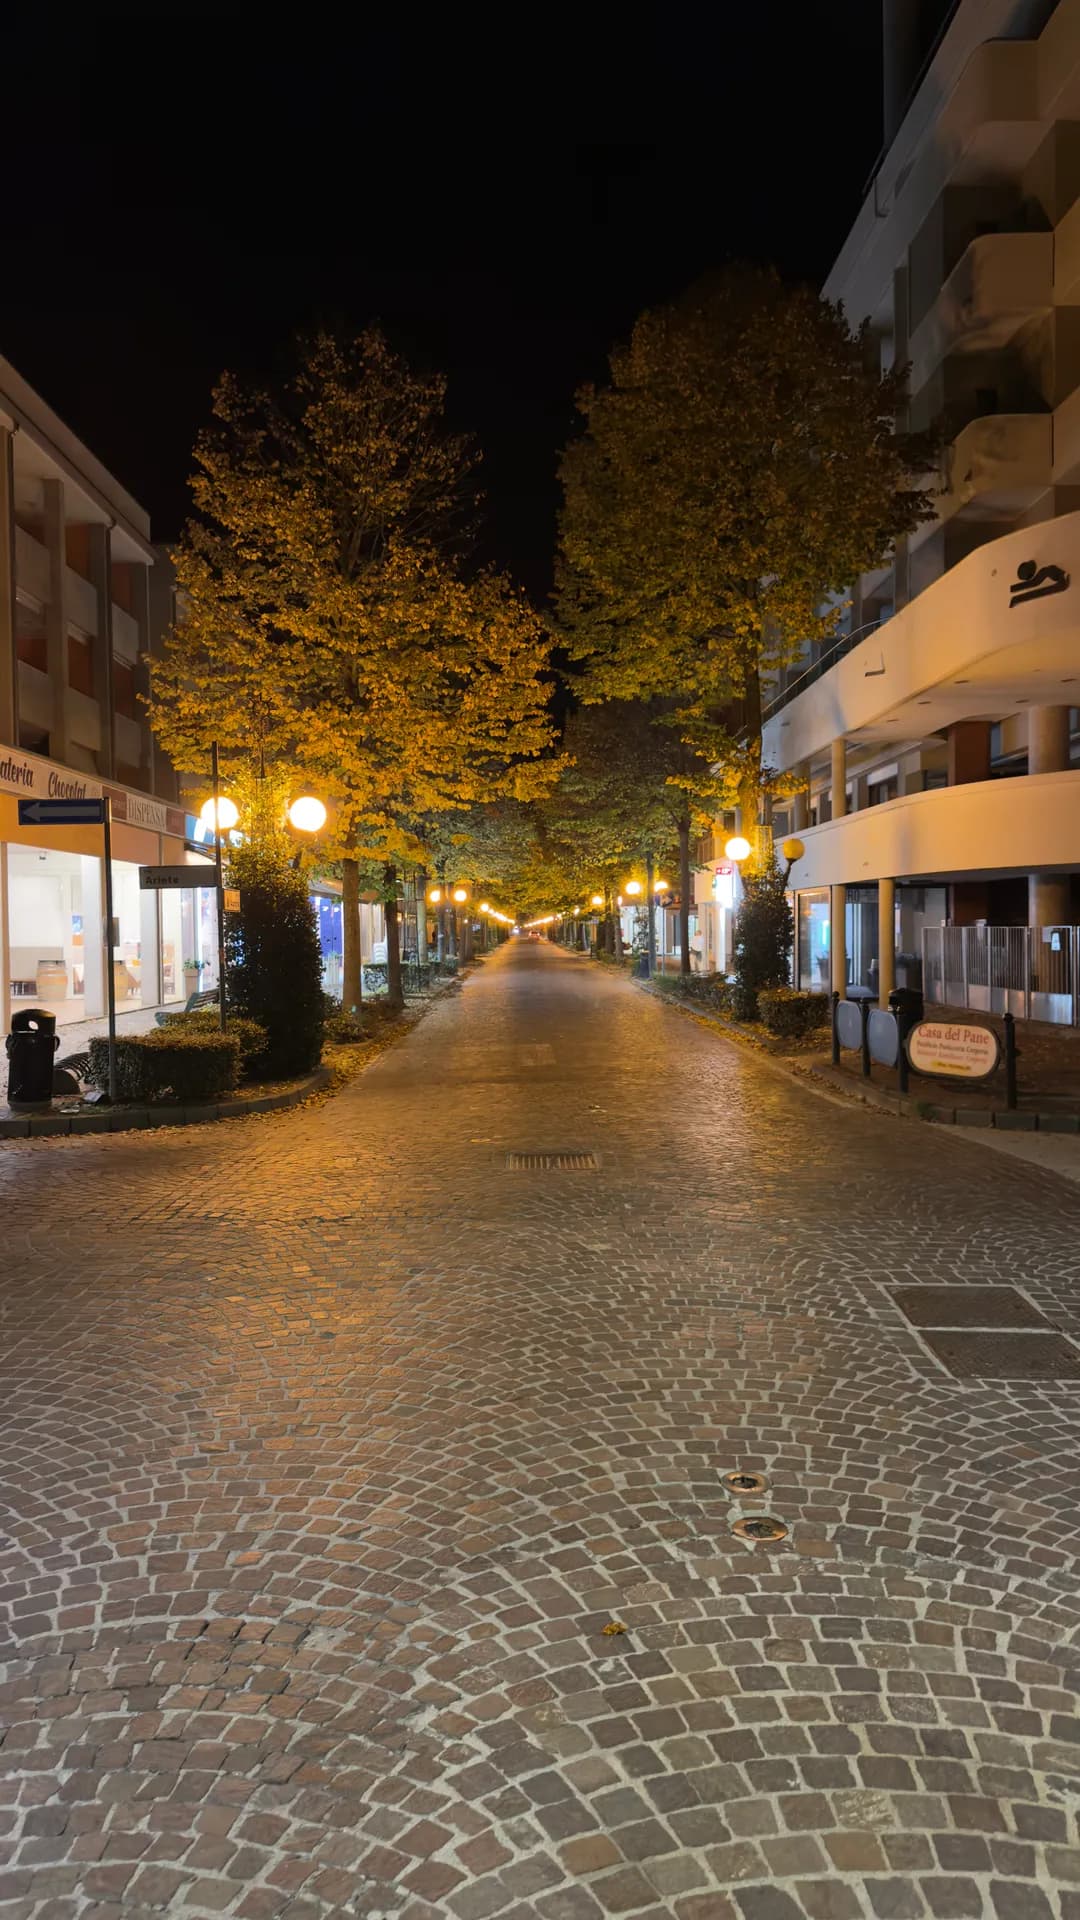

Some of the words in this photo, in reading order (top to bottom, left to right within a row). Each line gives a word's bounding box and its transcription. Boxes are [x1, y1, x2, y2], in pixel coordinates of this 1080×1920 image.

[918, 1026, 942, 1039] Casa
[945, 1027, 960, 1041] del
[963, 1029, 990, 1044] Pane
